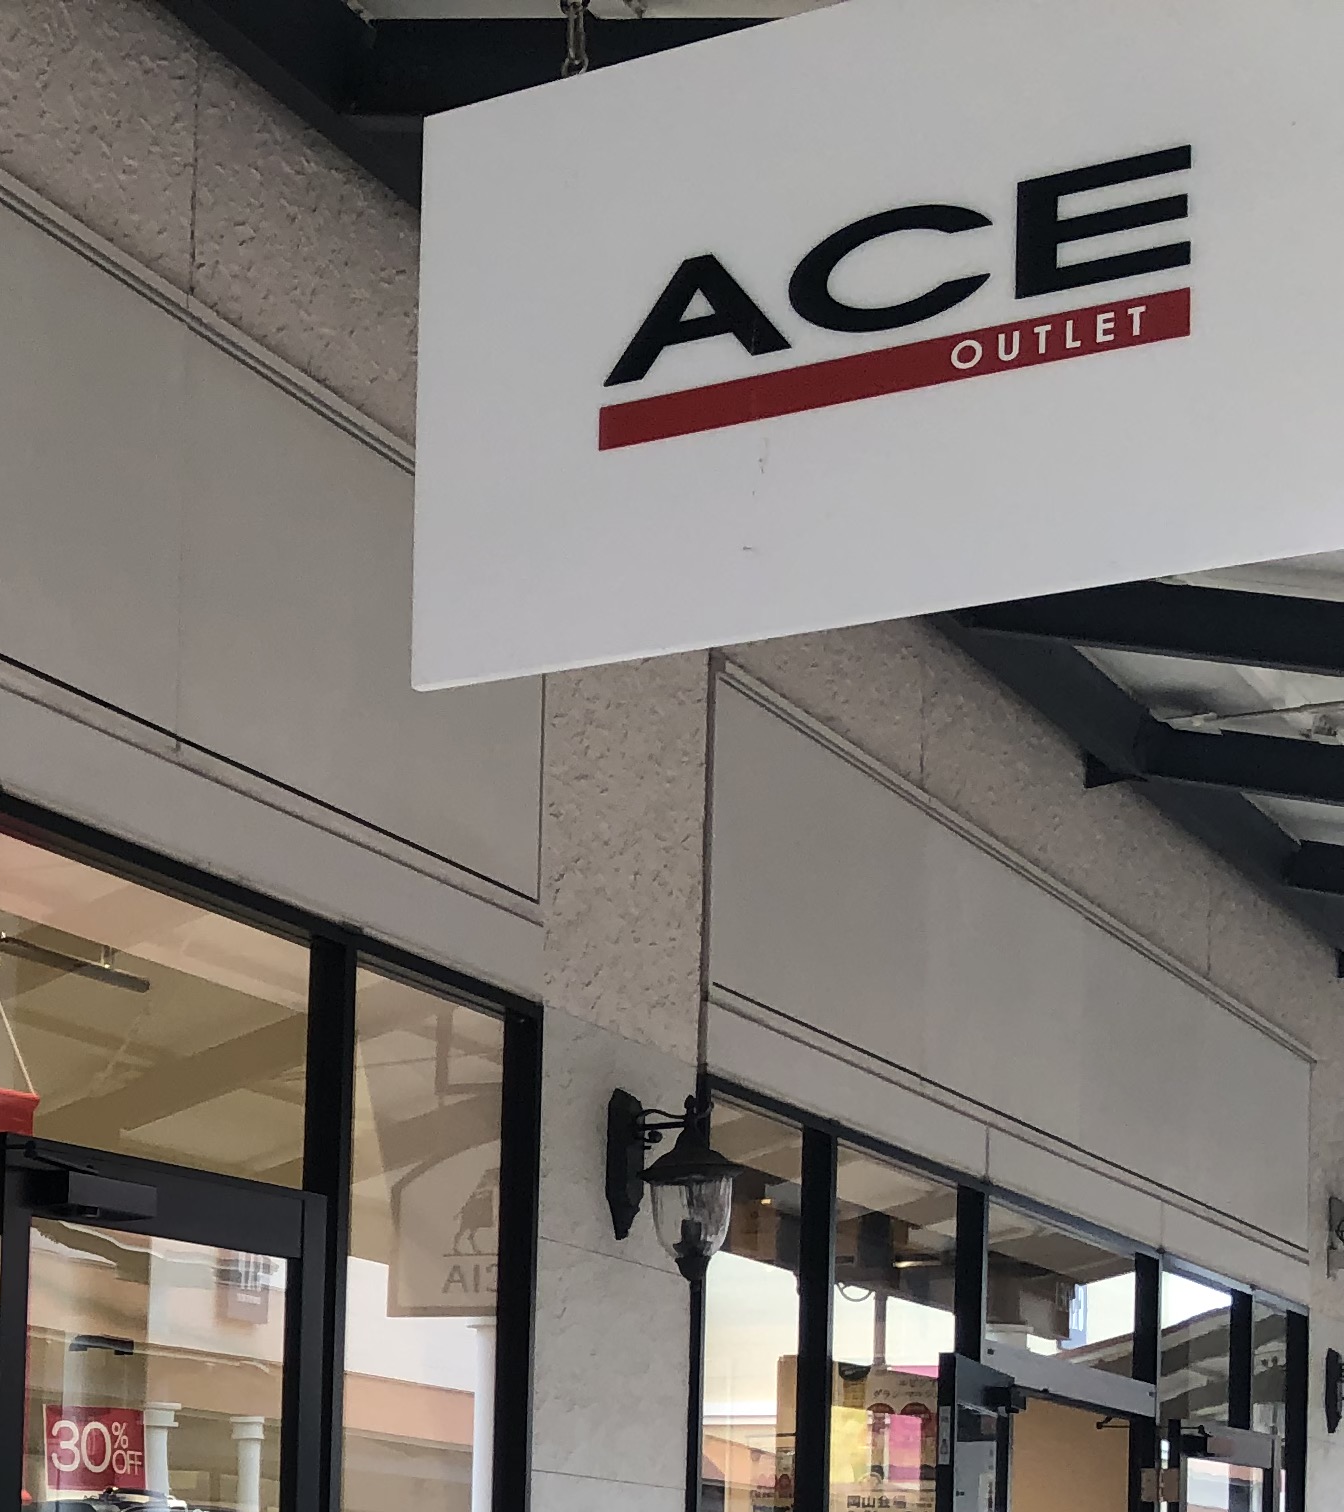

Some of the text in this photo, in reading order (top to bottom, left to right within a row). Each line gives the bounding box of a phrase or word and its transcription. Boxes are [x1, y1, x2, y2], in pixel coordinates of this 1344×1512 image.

[603, 144, 1192, 387] ACE
[949, 304, 1148, 371] OUTLET
[51, 1420, 129, 1473] 30%
[113, 1449, 143, 1476] OFF
